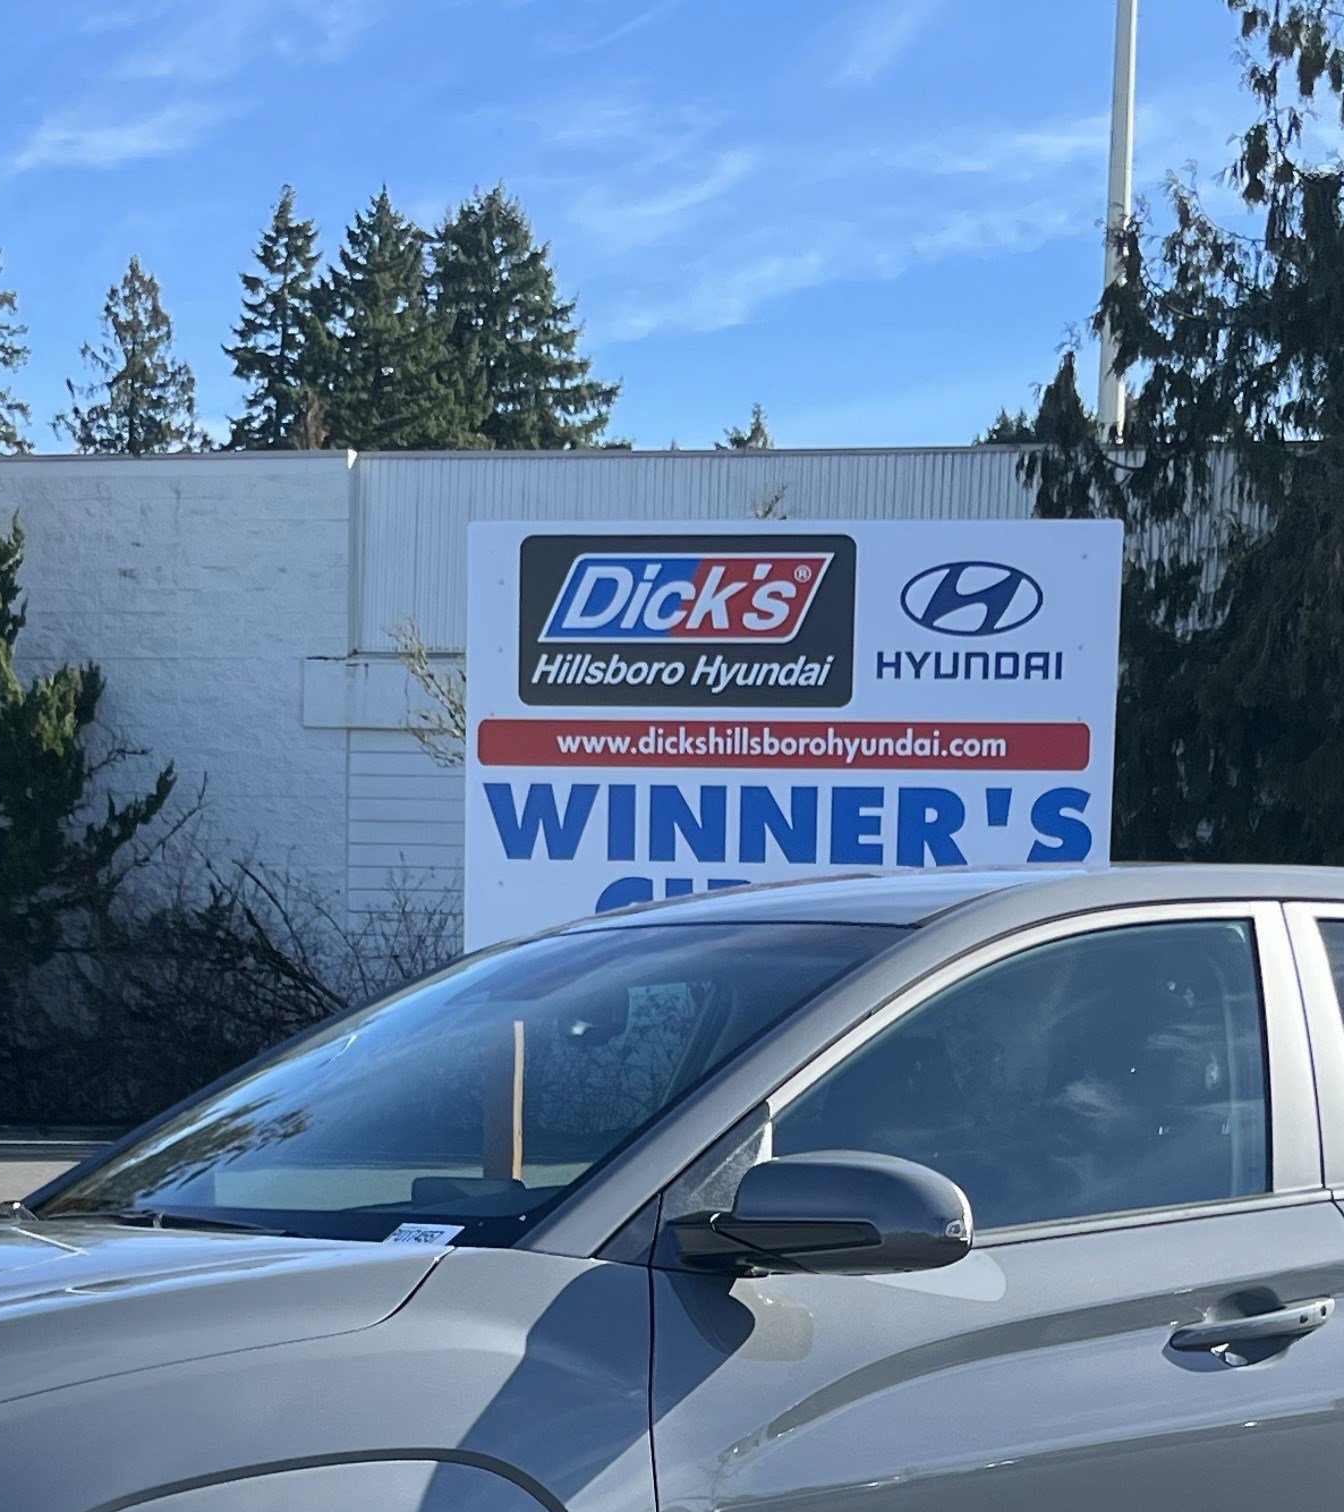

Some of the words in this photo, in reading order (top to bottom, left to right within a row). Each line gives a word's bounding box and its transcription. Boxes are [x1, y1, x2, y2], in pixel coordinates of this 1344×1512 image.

[560, 562, 801, 631] Dick's
[531, 653, 684, 687] Hillsboro
[690, 655, 834, 694] Hyundai
[876, 650, 1063, 681] HYUNDAI
[557, 726, 1006, 763] www.dickshillsborohyundai.com
[483, 782, 1093, 868] WINNER'S
